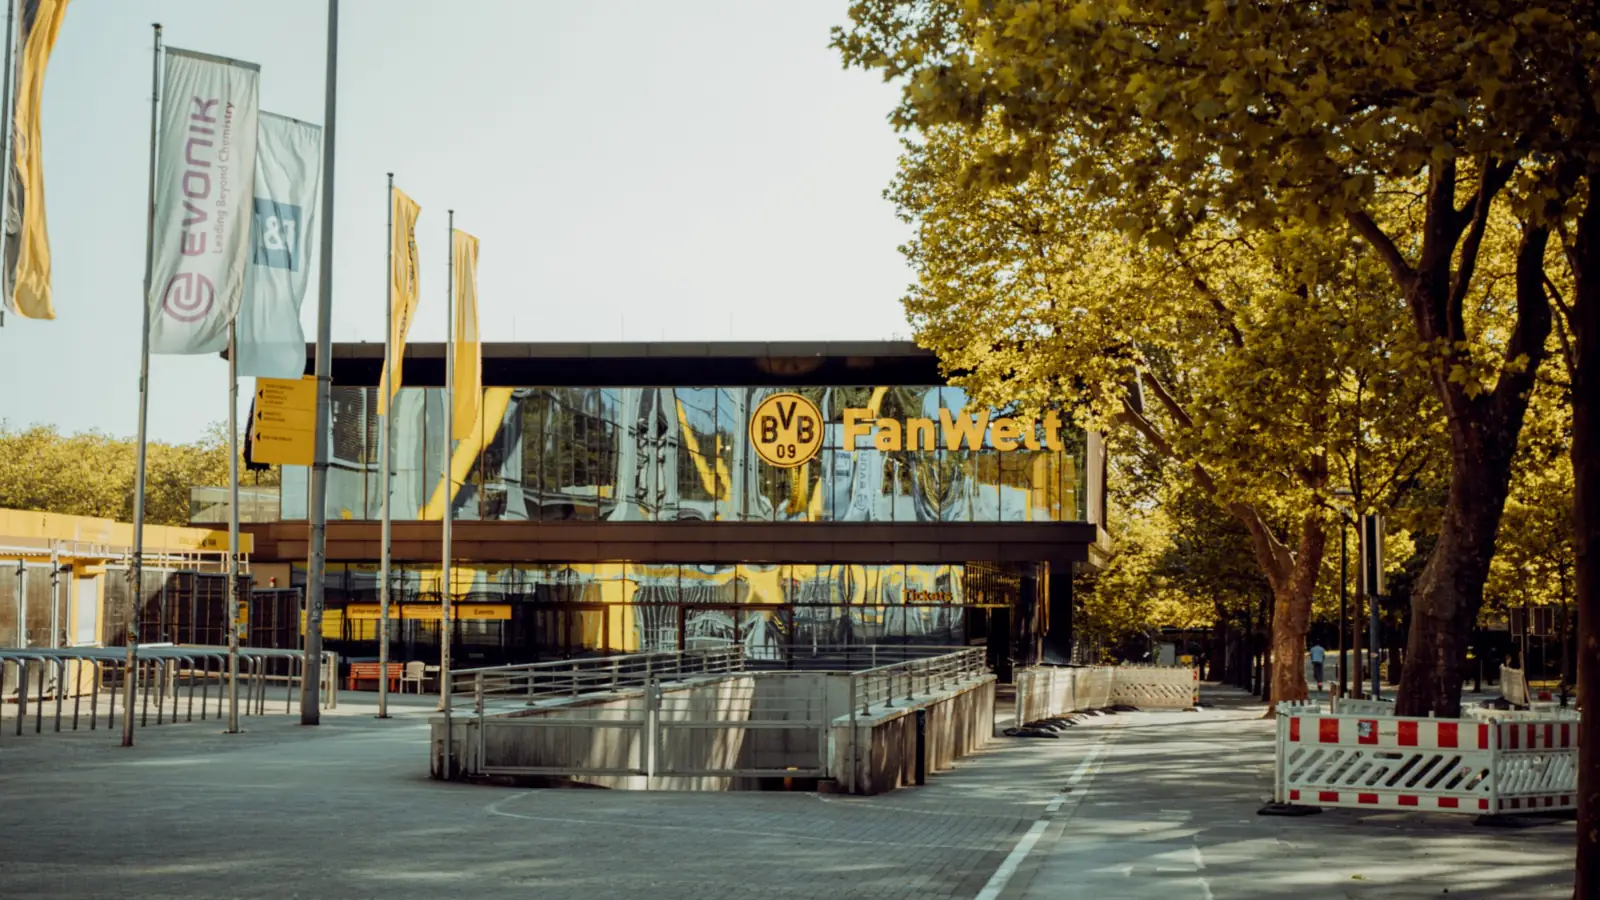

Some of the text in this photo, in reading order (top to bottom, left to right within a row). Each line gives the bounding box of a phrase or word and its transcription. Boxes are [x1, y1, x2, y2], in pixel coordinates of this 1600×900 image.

[180, 96, 219, 257] EVONIK
[212, 101, 235, 254] Leading Beyond Chemistry
[760, 401, 815, 444] BVB
[843, 407, 1063, 452] FanWelt
[776, 444, 797, 459] 09
[474, 608, 495, 616] Events
[902, 588, 953, 602] Tickets
